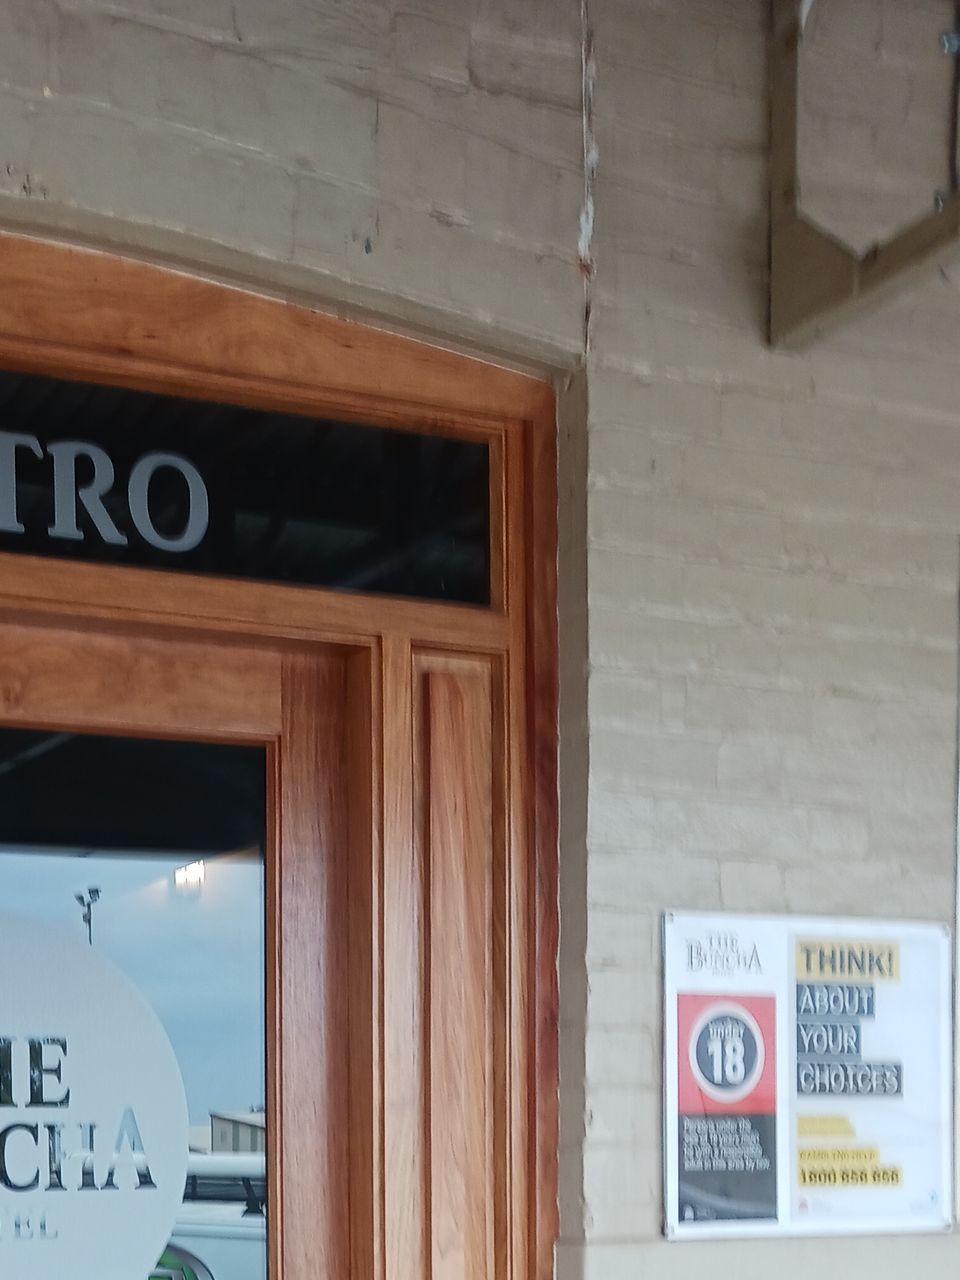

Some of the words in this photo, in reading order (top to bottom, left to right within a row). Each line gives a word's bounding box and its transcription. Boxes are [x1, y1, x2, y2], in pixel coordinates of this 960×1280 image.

[799, 944, 893, 976] THINK!
[799, 985, 873, 1016] ABOUT
[799, 1024, 856, 1054] YOUR
[707, 1039, 745, 1084] 18
[799, 1065, 898, 1095] CHOICES
